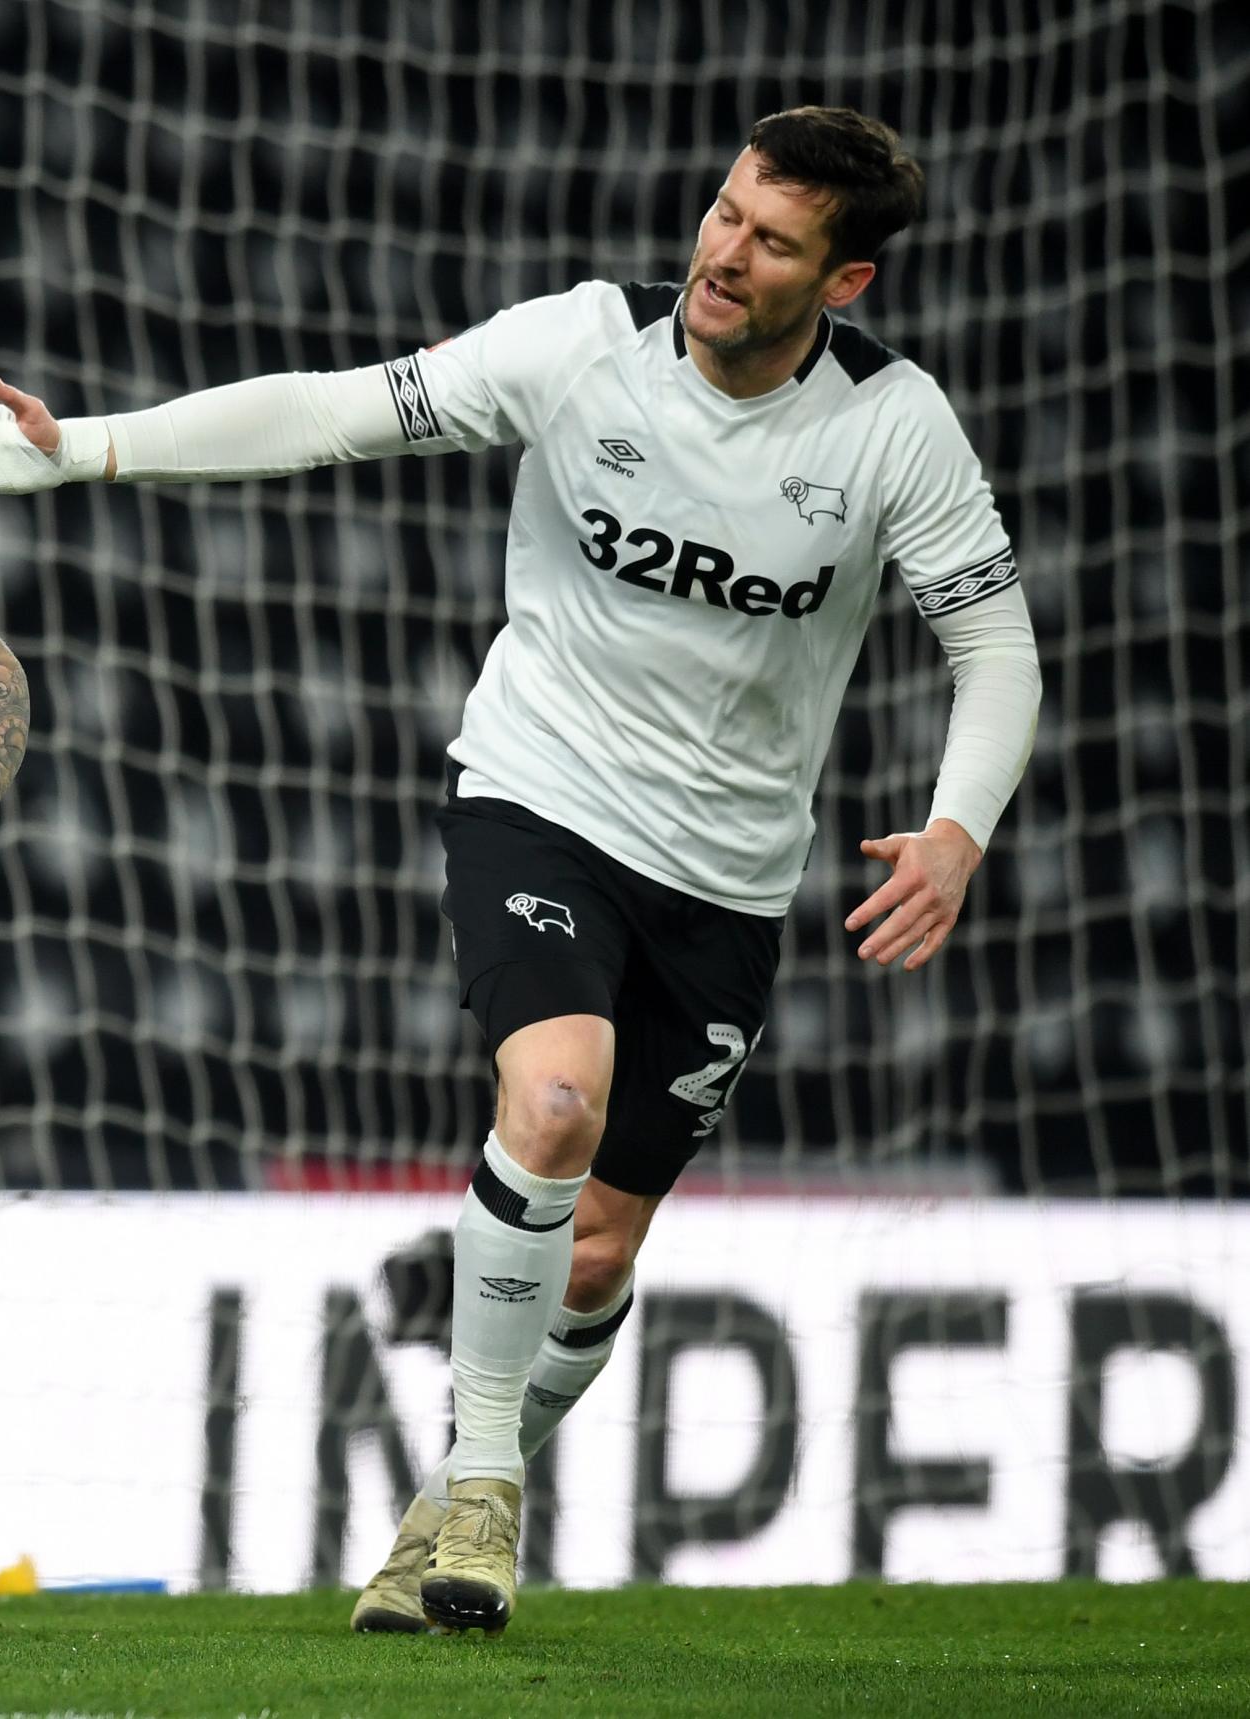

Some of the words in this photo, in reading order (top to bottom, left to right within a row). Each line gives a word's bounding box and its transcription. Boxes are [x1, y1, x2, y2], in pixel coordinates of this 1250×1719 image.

[595, 456, 635, 479] umbro
[578, 508, 836, 620] 32Red
[479, 1290, 537, 1303] umbro
